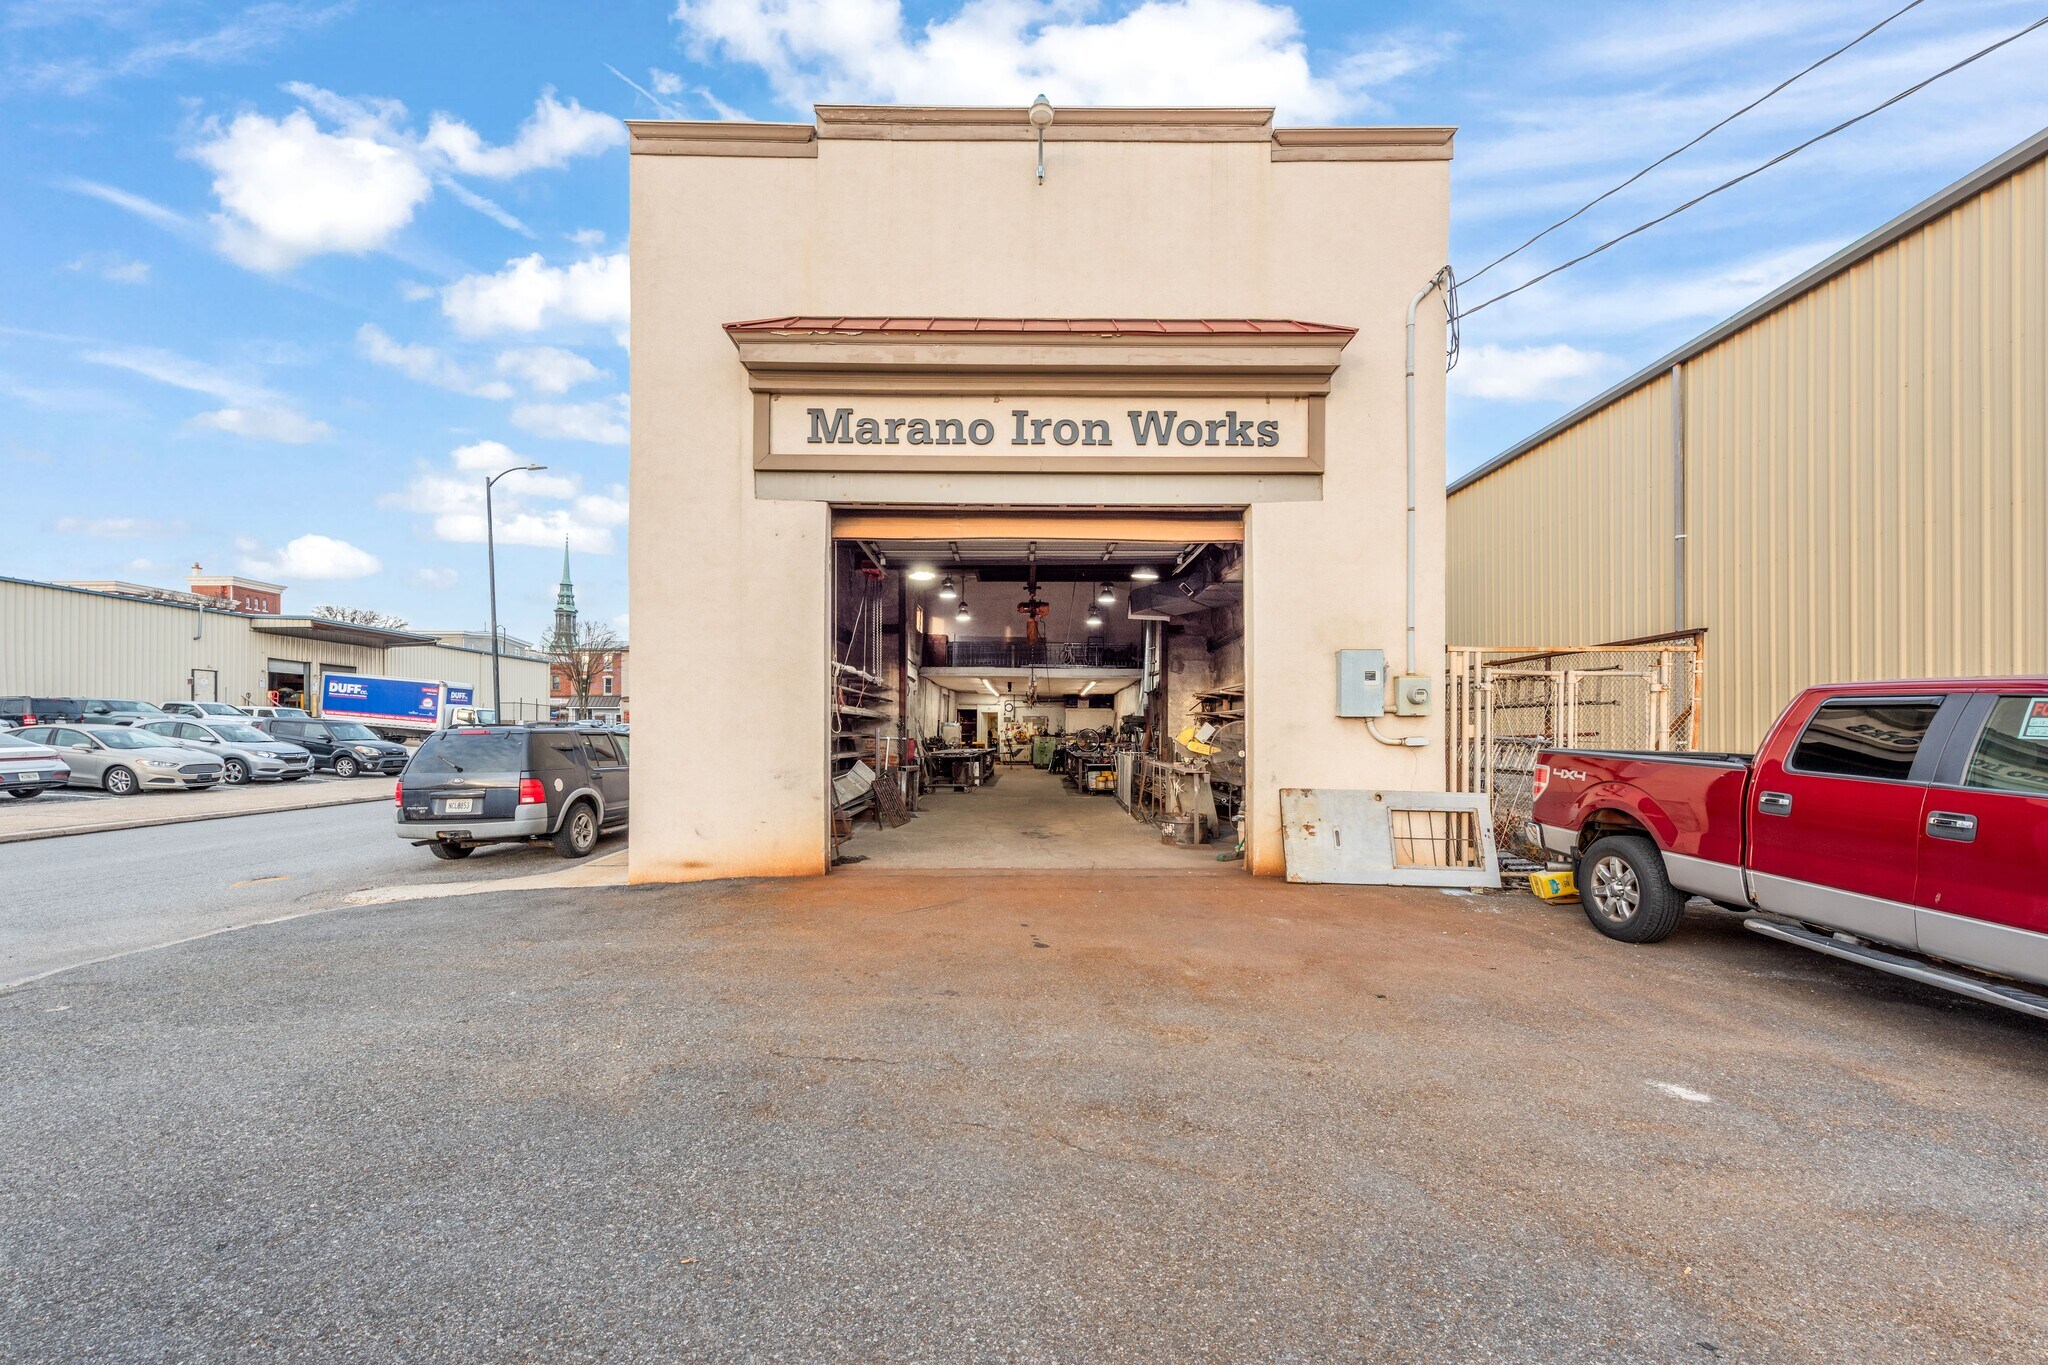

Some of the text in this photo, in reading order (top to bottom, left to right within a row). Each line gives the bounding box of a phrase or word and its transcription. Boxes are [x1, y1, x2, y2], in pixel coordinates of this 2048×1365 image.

[806, 407, 1279, 447] Marano Iron Works
[328, 682, 362, 694] DUFF
